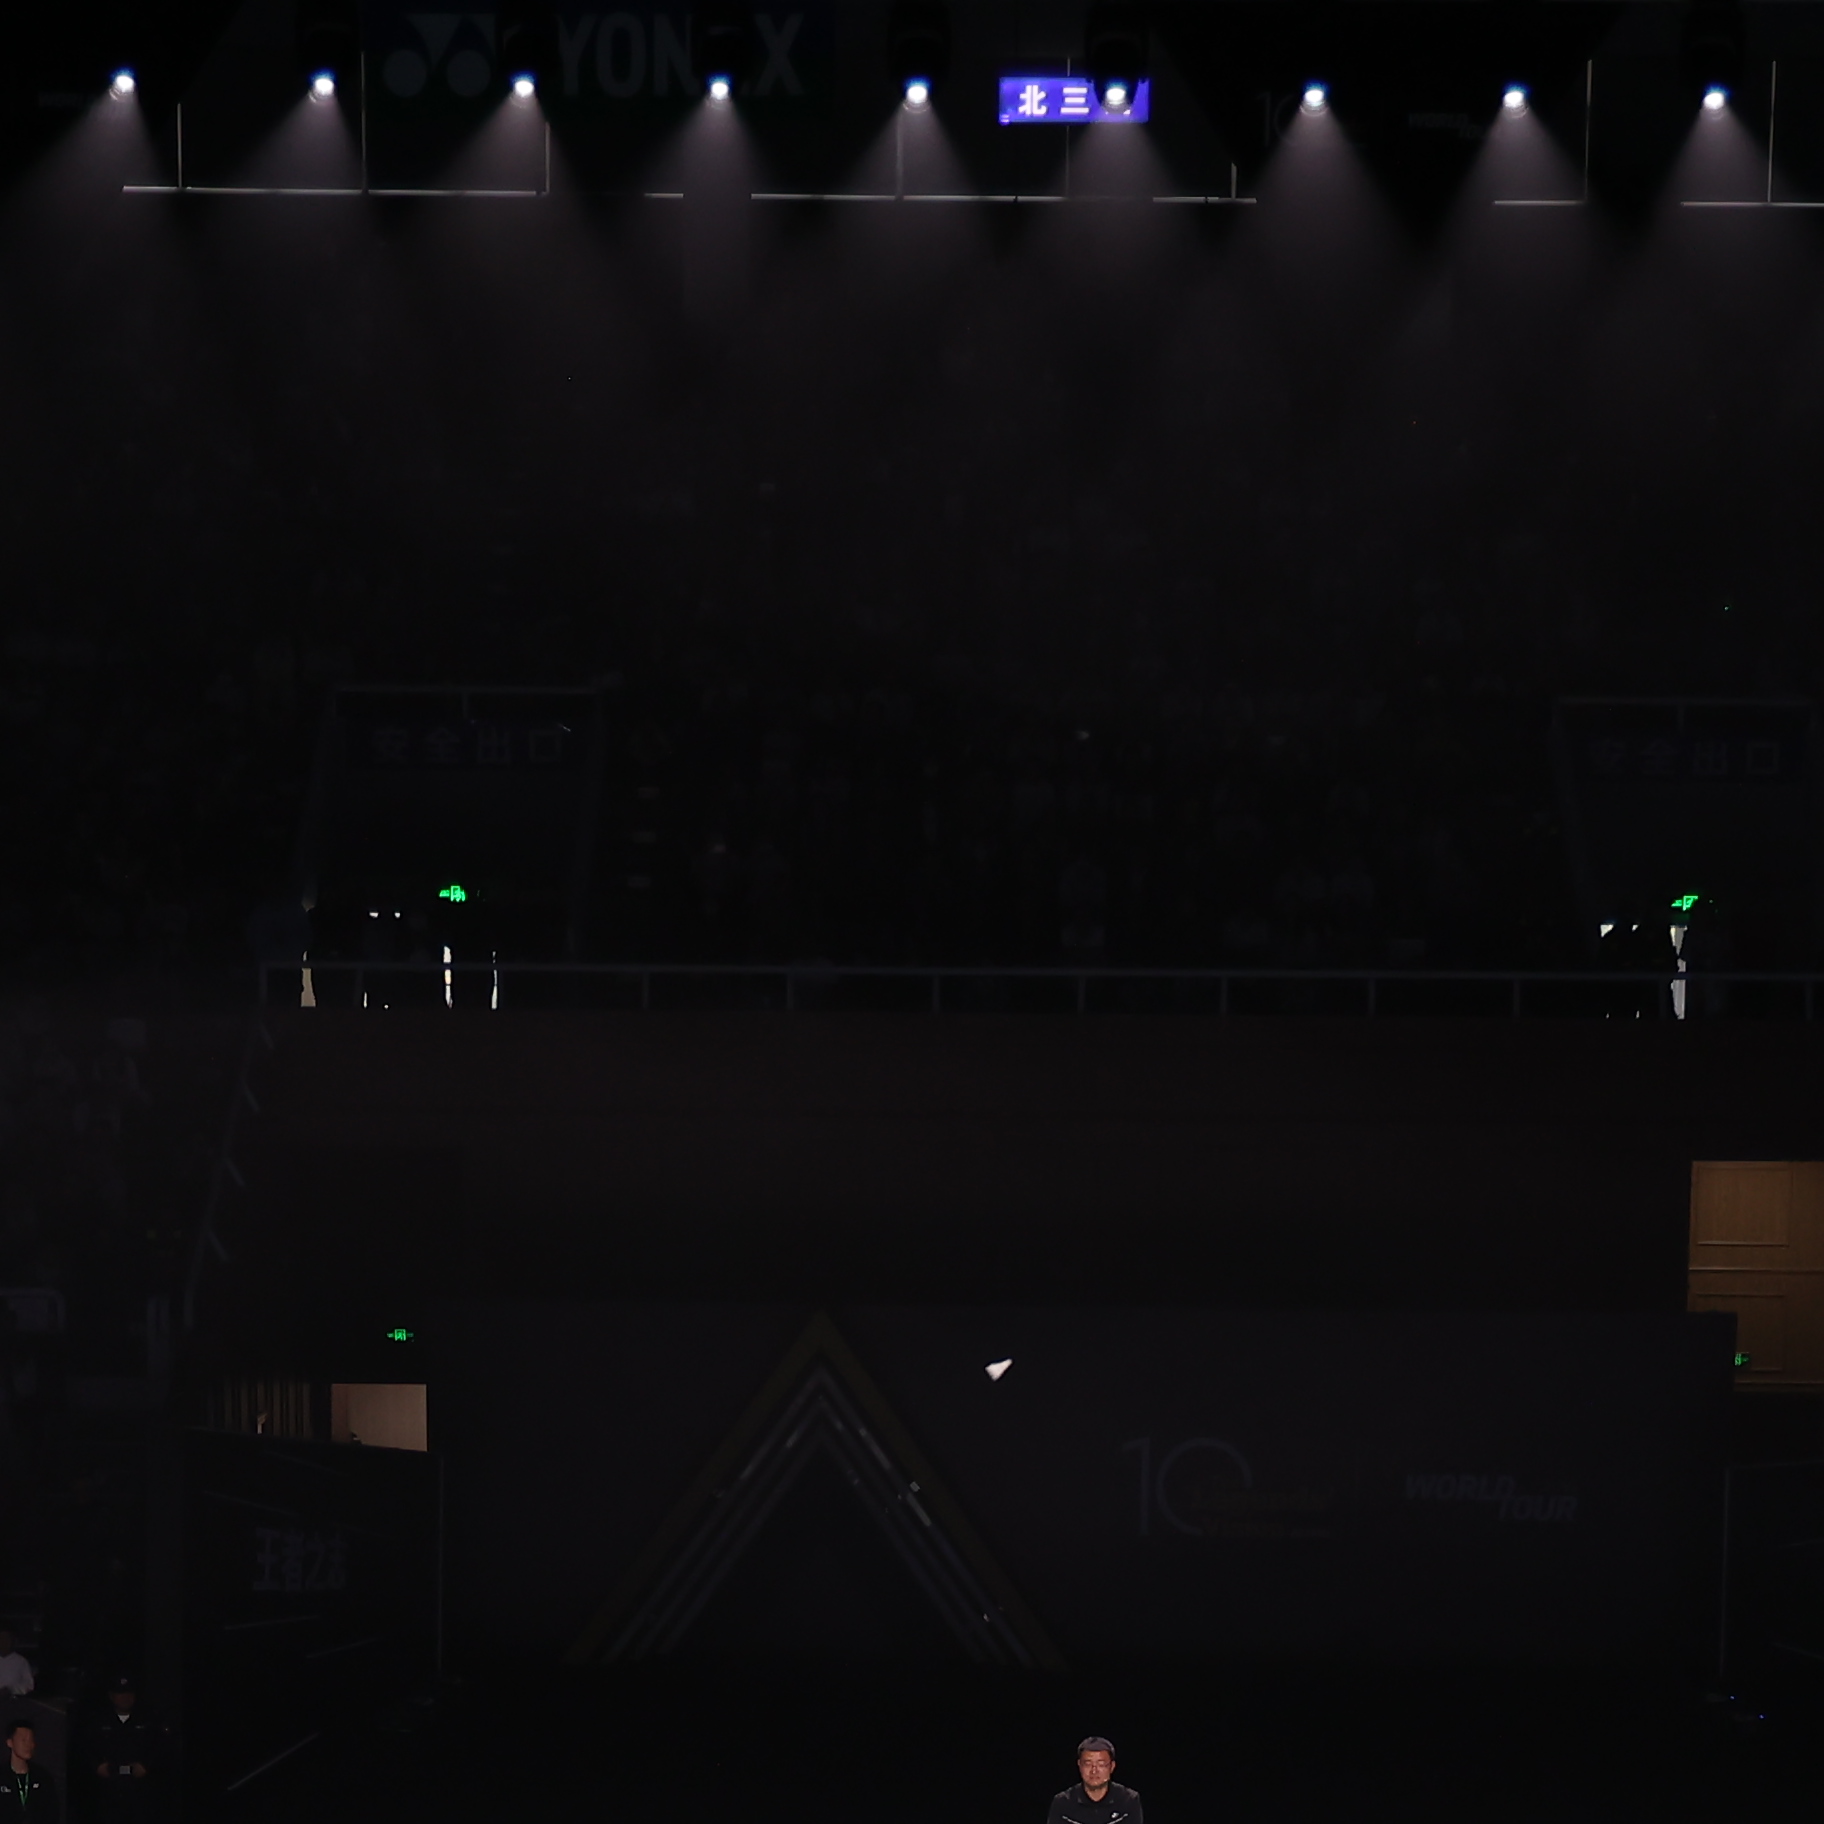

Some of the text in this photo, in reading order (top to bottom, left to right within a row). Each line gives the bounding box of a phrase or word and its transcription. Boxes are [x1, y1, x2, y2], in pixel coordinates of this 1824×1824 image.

[561, 13, 805, 97] YONX
[1018, 84, 1131, 116] 北三
[1406, 1475, 1515, 1502] WORLD
[1498, 1495, 1576, 1521] TOUR
